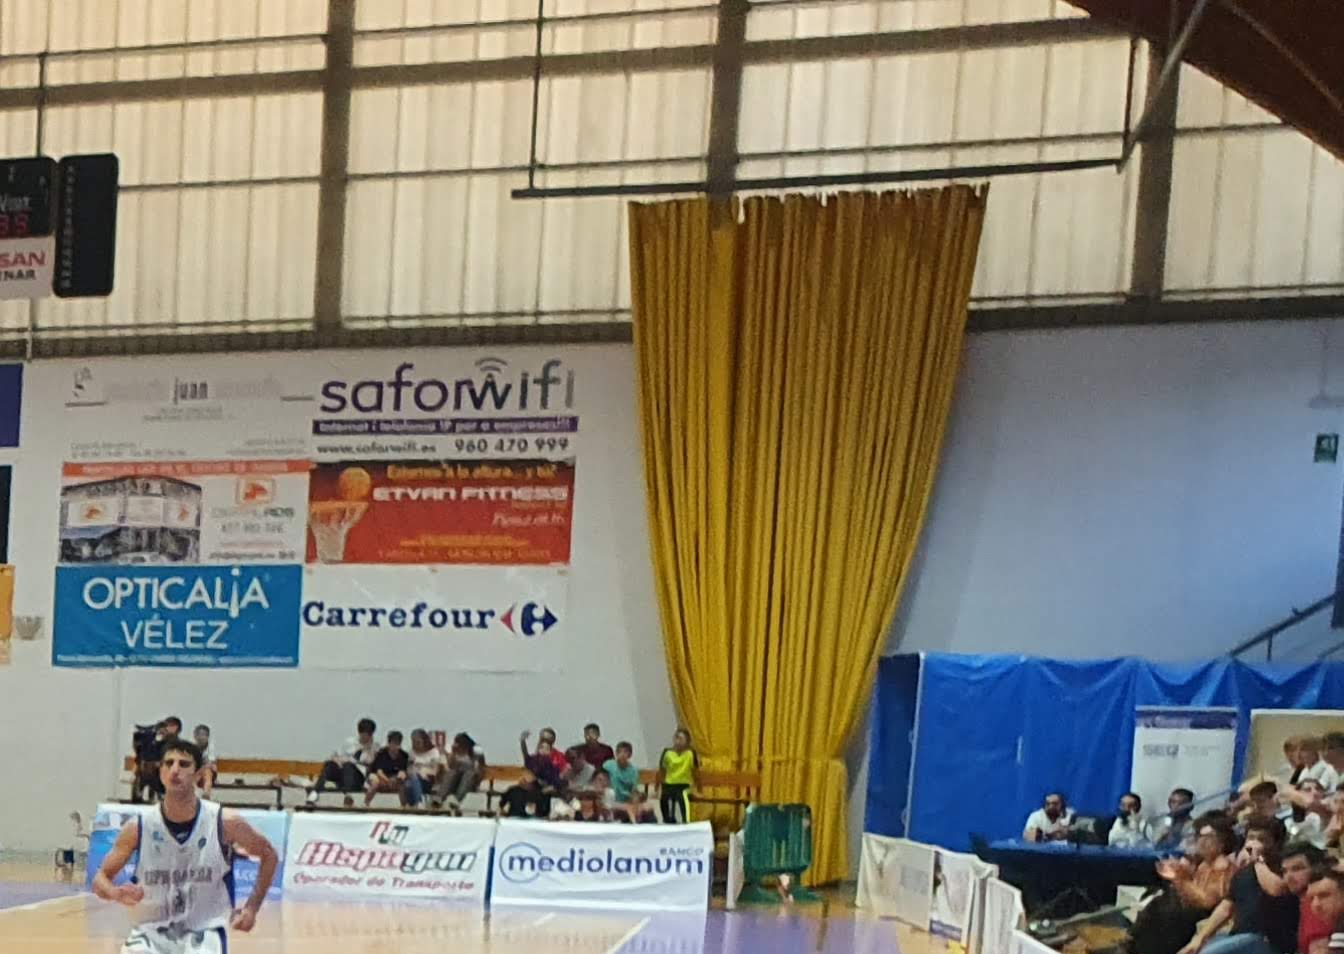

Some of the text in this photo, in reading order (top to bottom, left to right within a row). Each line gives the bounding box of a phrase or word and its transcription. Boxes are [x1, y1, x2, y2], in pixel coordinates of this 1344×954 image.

[320, 359, 575, 413] saforwifi
[302, 601, 496, 629] Carrefour
[121, 613, 230, 650] VÉLEZ
[508, 849, 703, 874] mediolanum
[366, 876, 386, 888] de
